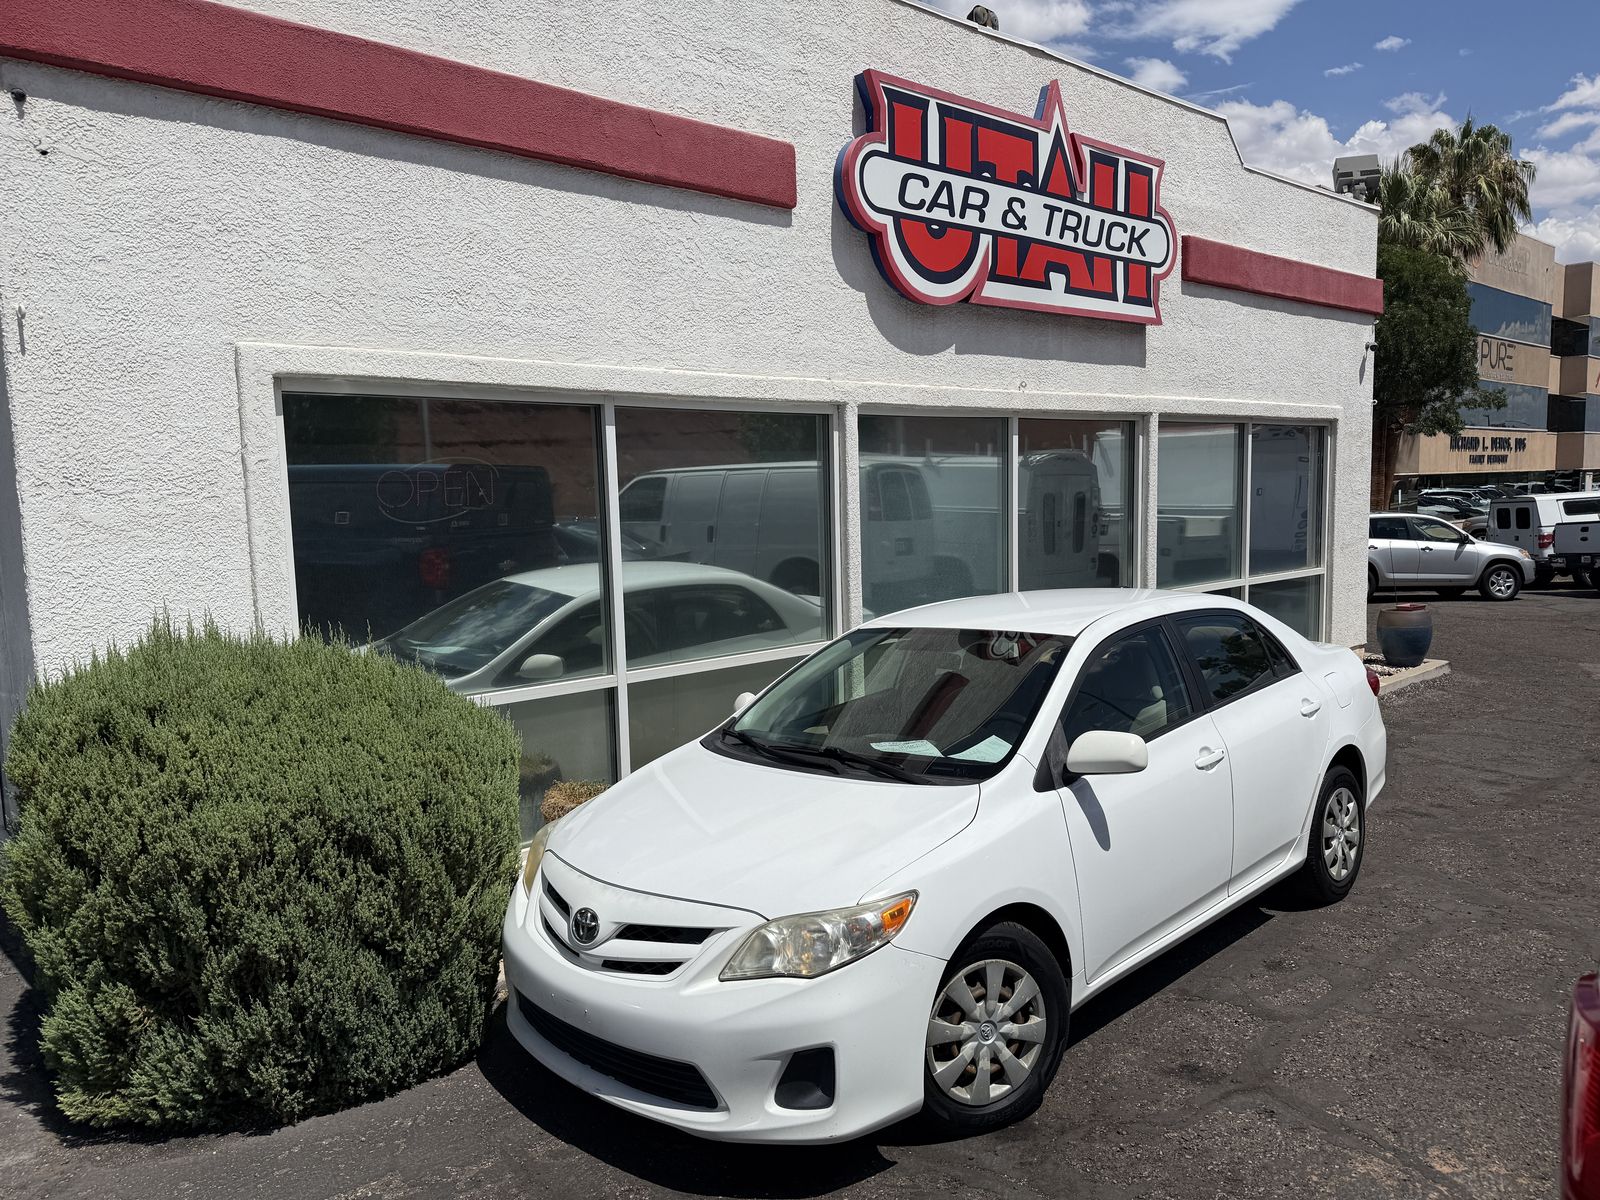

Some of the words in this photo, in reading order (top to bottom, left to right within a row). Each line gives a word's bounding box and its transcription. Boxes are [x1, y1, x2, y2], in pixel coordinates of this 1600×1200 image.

[881, 85, 1153, 308] UTAH
[898, 172, 990, 223] CAR
[1001, 197, 1028, 231] &
[1042, 203, 1150, 258] TRUCK
[1480, 338, 1513, 370] PURE
[376, 471, 494, 507] OPEN
